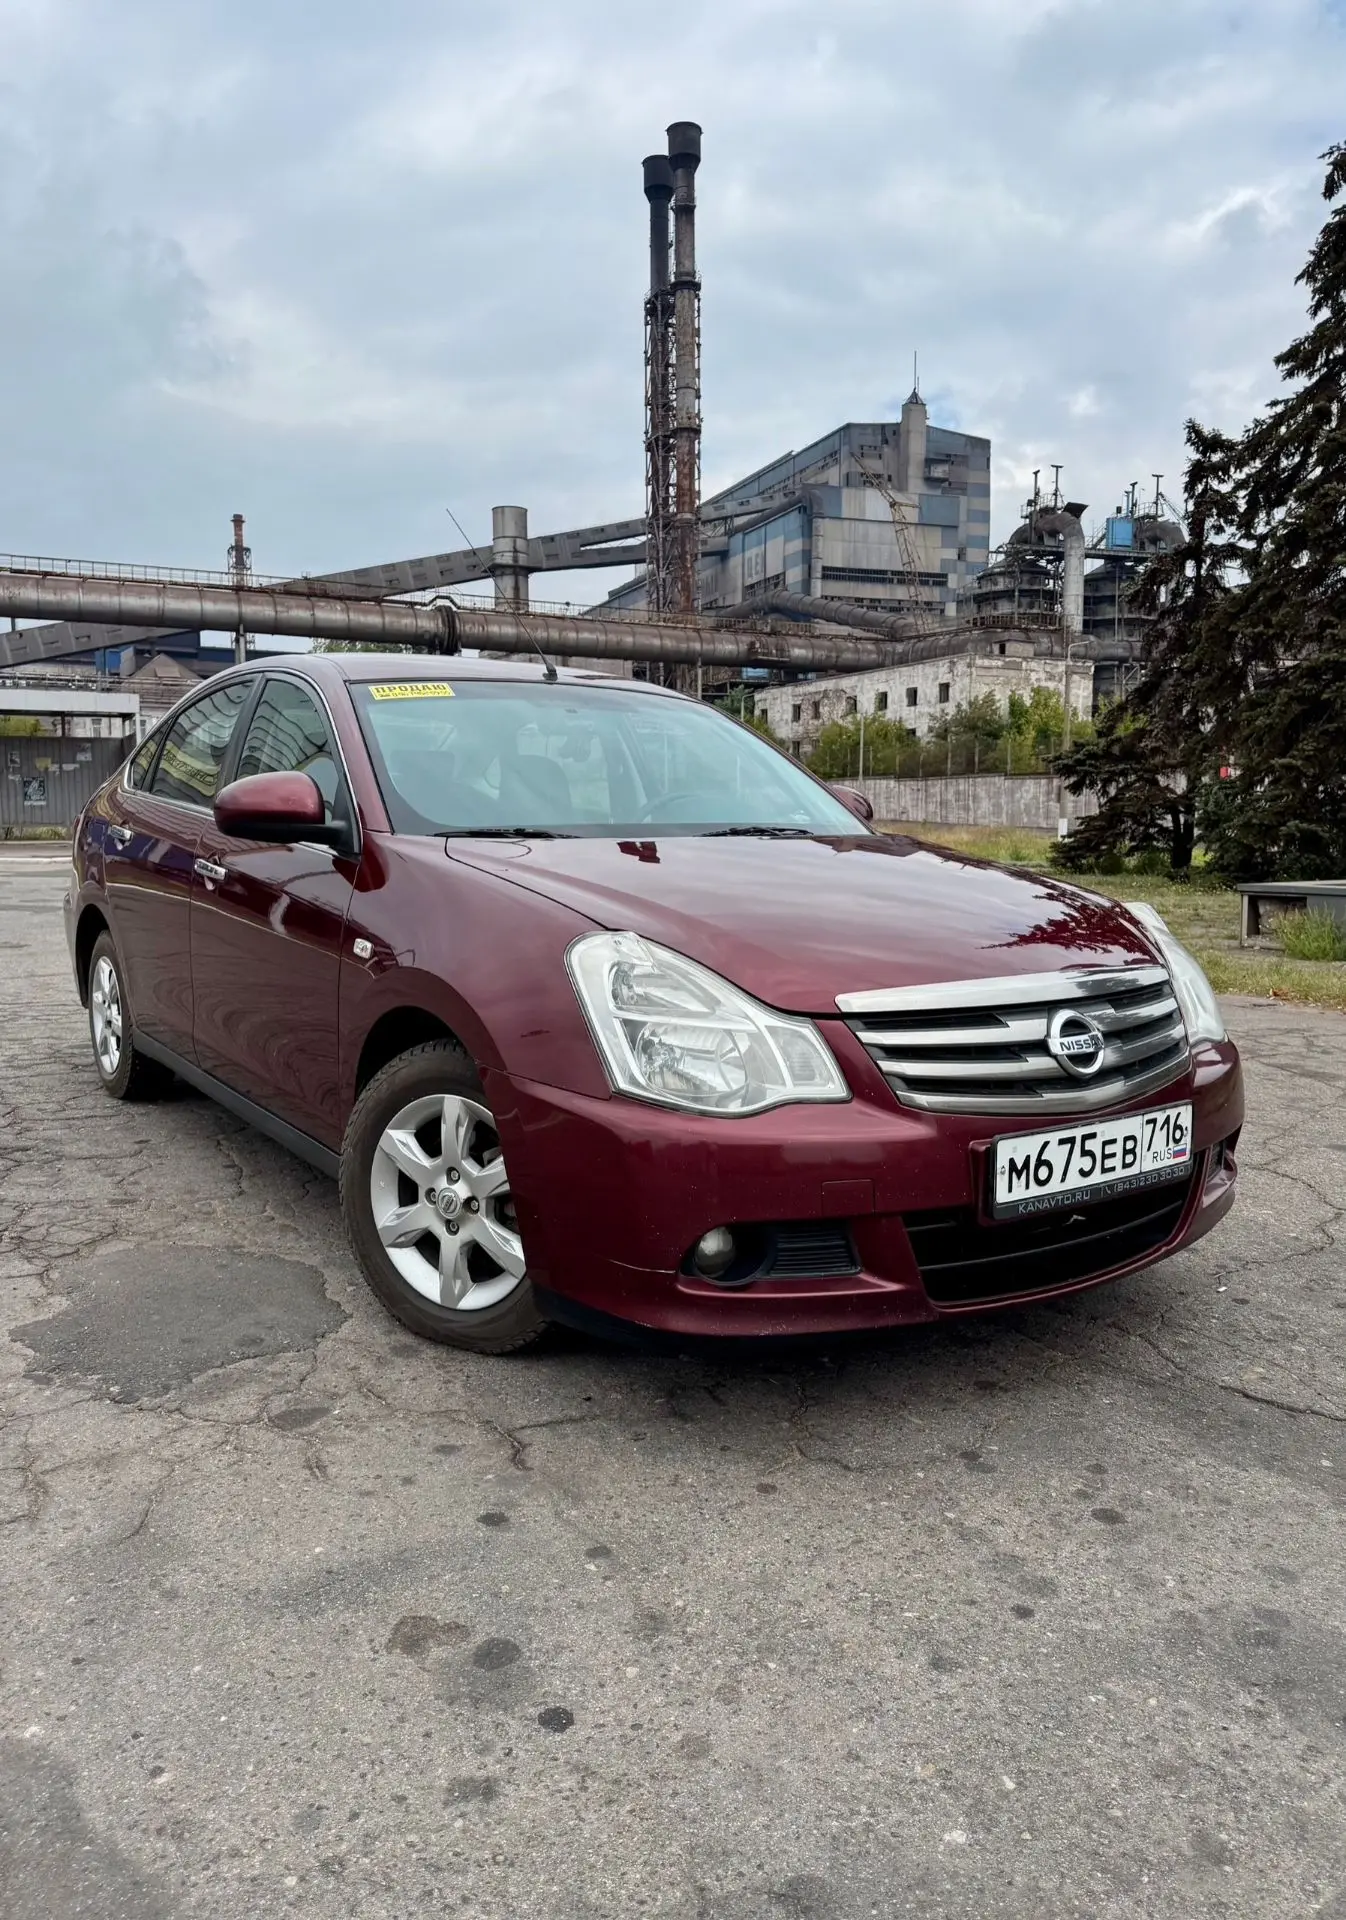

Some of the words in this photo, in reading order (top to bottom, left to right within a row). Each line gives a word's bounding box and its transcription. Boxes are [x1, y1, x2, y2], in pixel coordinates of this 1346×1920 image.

[374, 684, 447, 694] ПРОДАЮ
[1059, 1038, 1104, 1052] NISSAN
[1145, 1112, 1184, 1153] 716
[1152, 1148, 1172, 1164] RUS
[1018, 1190, 1091, 1214] KANAVTO.RU
